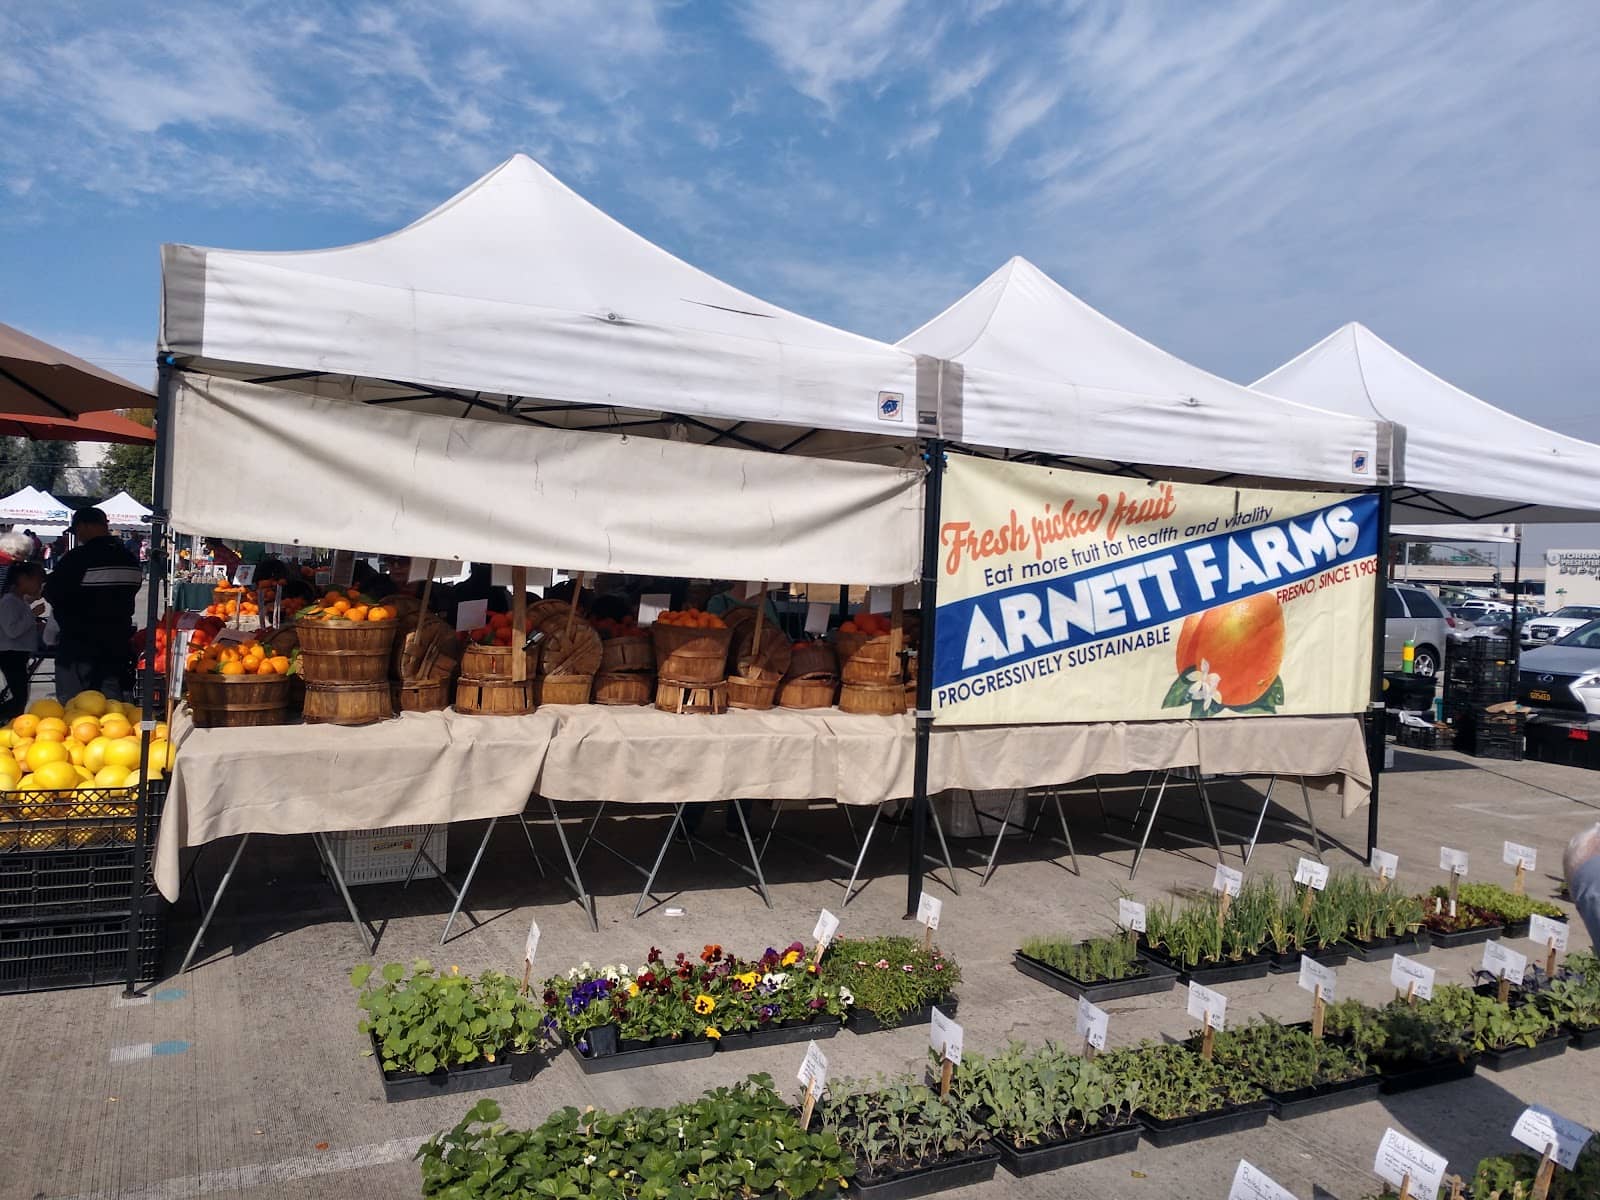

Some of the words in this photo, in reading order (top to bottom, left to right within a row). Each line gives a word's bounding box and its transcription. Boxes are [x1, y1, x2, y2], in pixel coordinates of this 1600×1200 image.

[941, 509, 1030, 575] Fresh
[1032, 493, 1109, 560] picked
[1106, 483, 1177, 541] fruit
[984, 563, 1013, 587] Eat
[1022, 556, 1068, 579] more
[1071, 543, 1100, 567] fruit
[1103, 540, 1124, 558] for
[1127, 526, 1178, 551] health
[1184, 517, 1219, 538] and
[1225, 506, 1273, 530] vitality
[962, 554, 1182, 670] ARNETT
[1184, 505, 1360, 602] FARMS
[1276, 579, 1316, 605] FRESNO,
[1319, 565, 1351, 590] SINCE
[937, 653, 1063, 709] PROGRESSIVELY
[1068, 625, 1171, 668] SUSTAINABLE
